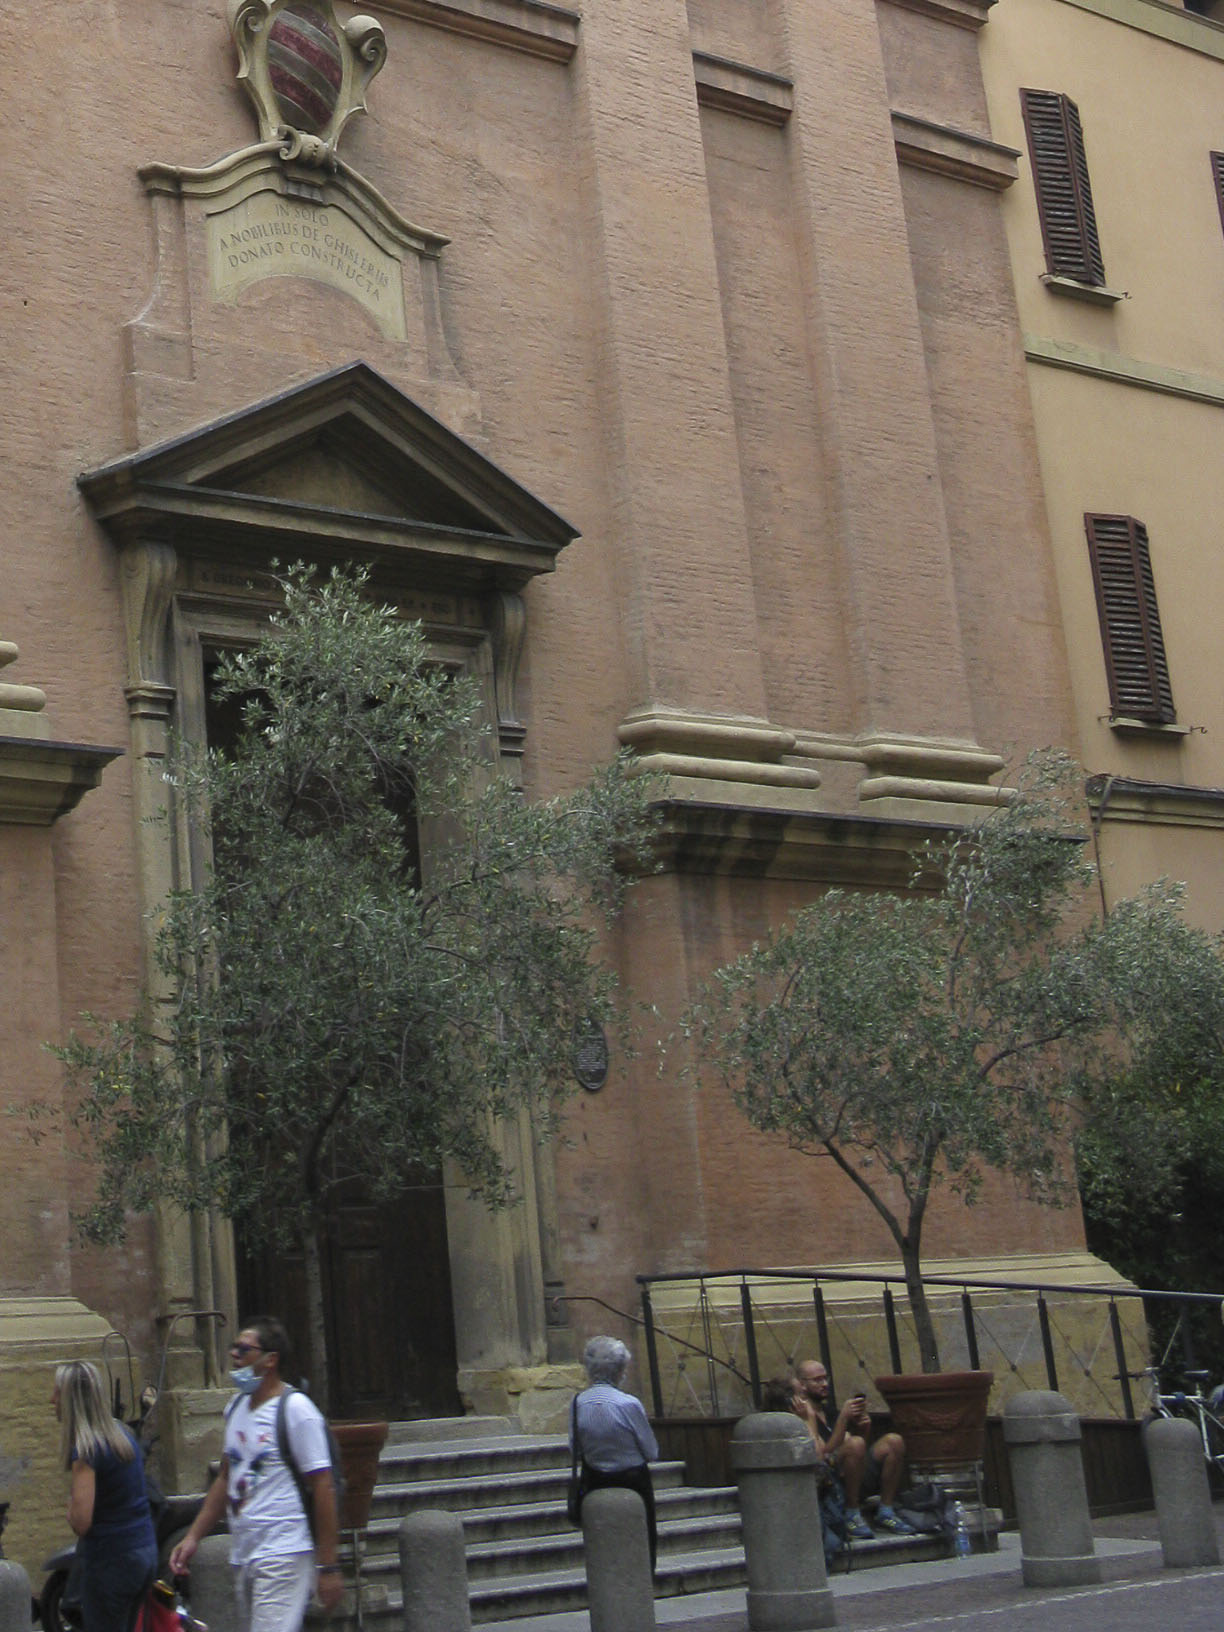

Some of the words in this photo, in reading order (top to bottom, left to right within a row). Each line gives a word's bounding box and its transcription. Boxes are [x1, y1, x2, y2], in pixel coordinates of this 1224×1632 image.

[276, 204, 290, 217] IN
[294, 207, 329, 226] SOLO
[220, 238, 229, 250] A
[230, 222, 299, 247] NOBILIBUS
[302, 225, 319, 241] DE
[228, 241, 284, 267] DONATO
[290, 241, 380, 301] CONSTRUCTA
